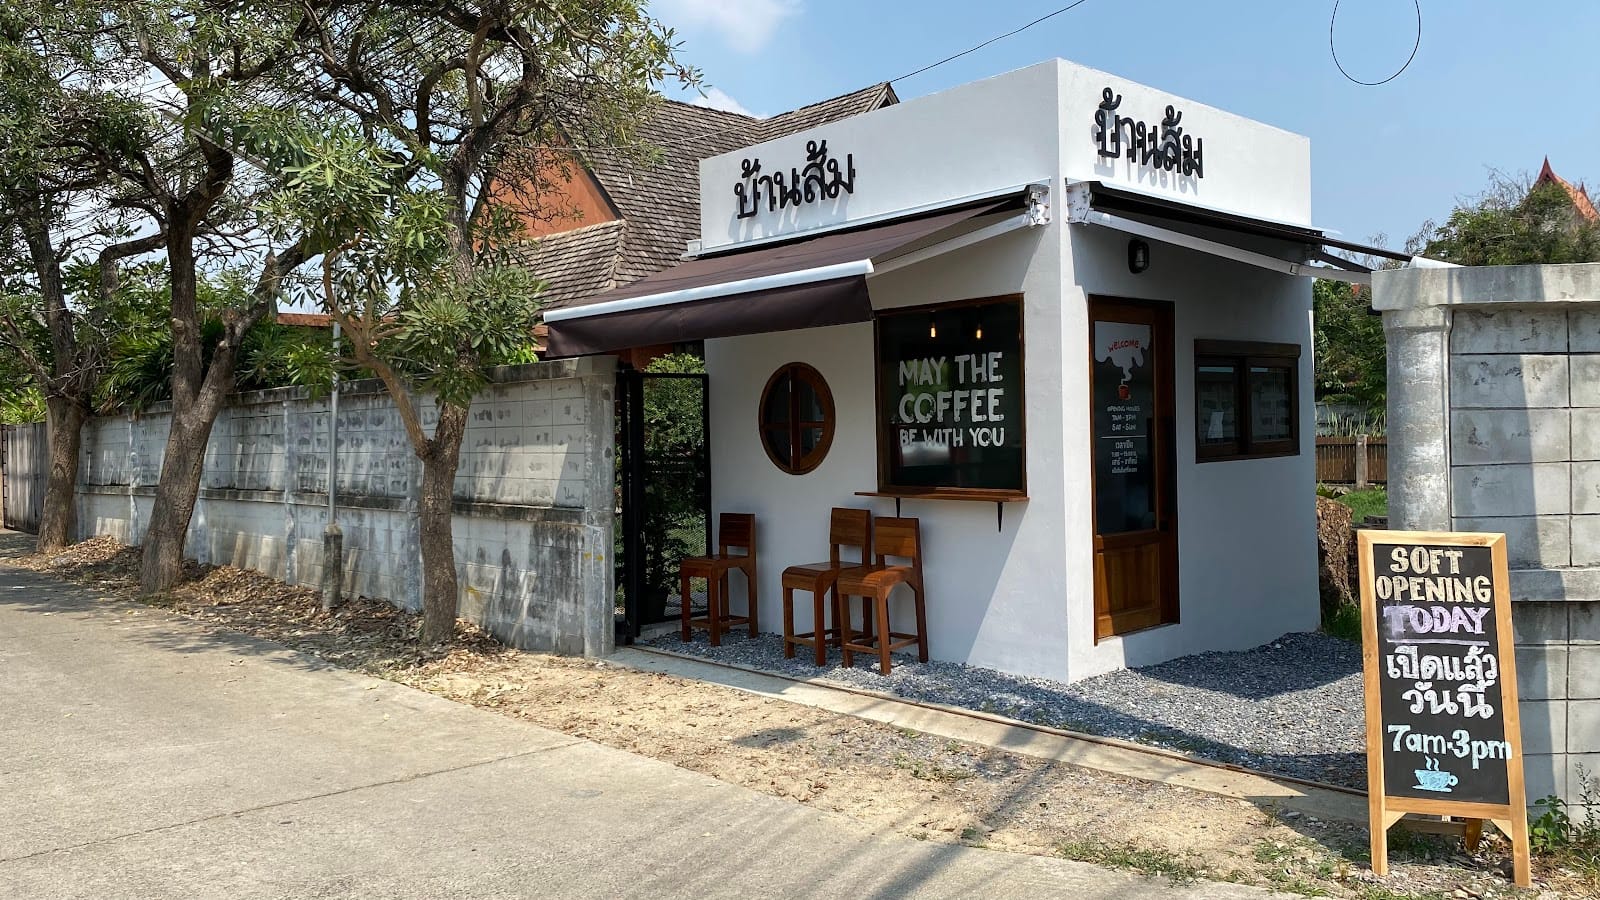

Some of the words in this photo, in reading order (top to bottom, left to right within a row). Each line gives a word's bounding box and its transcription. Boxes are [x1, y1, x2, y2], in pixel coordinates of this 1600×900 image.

[1094, 87, 1203, 178] บ้านส้ม
[734, 140, 856, 219] บ้านส้ม
[899, 356, 946, 386] MAY
[954, 352, 1003, 384] THE
[899, 388, 1004, 423] COFFEE
[900, 429, 917, 446] BE
[922, 428, 963, 447] WITH
[969, 428, 1004, 447] YOU
[1390, 547, 1463, 574] SOFT
[1375, 575, 1491, 603] OPENING
[1383, 604, 1491, 634] TODAY
[1386, 645, 1498, 681] เปิดแล้ว
[1402, 679, 1495, 720] วันนี้
